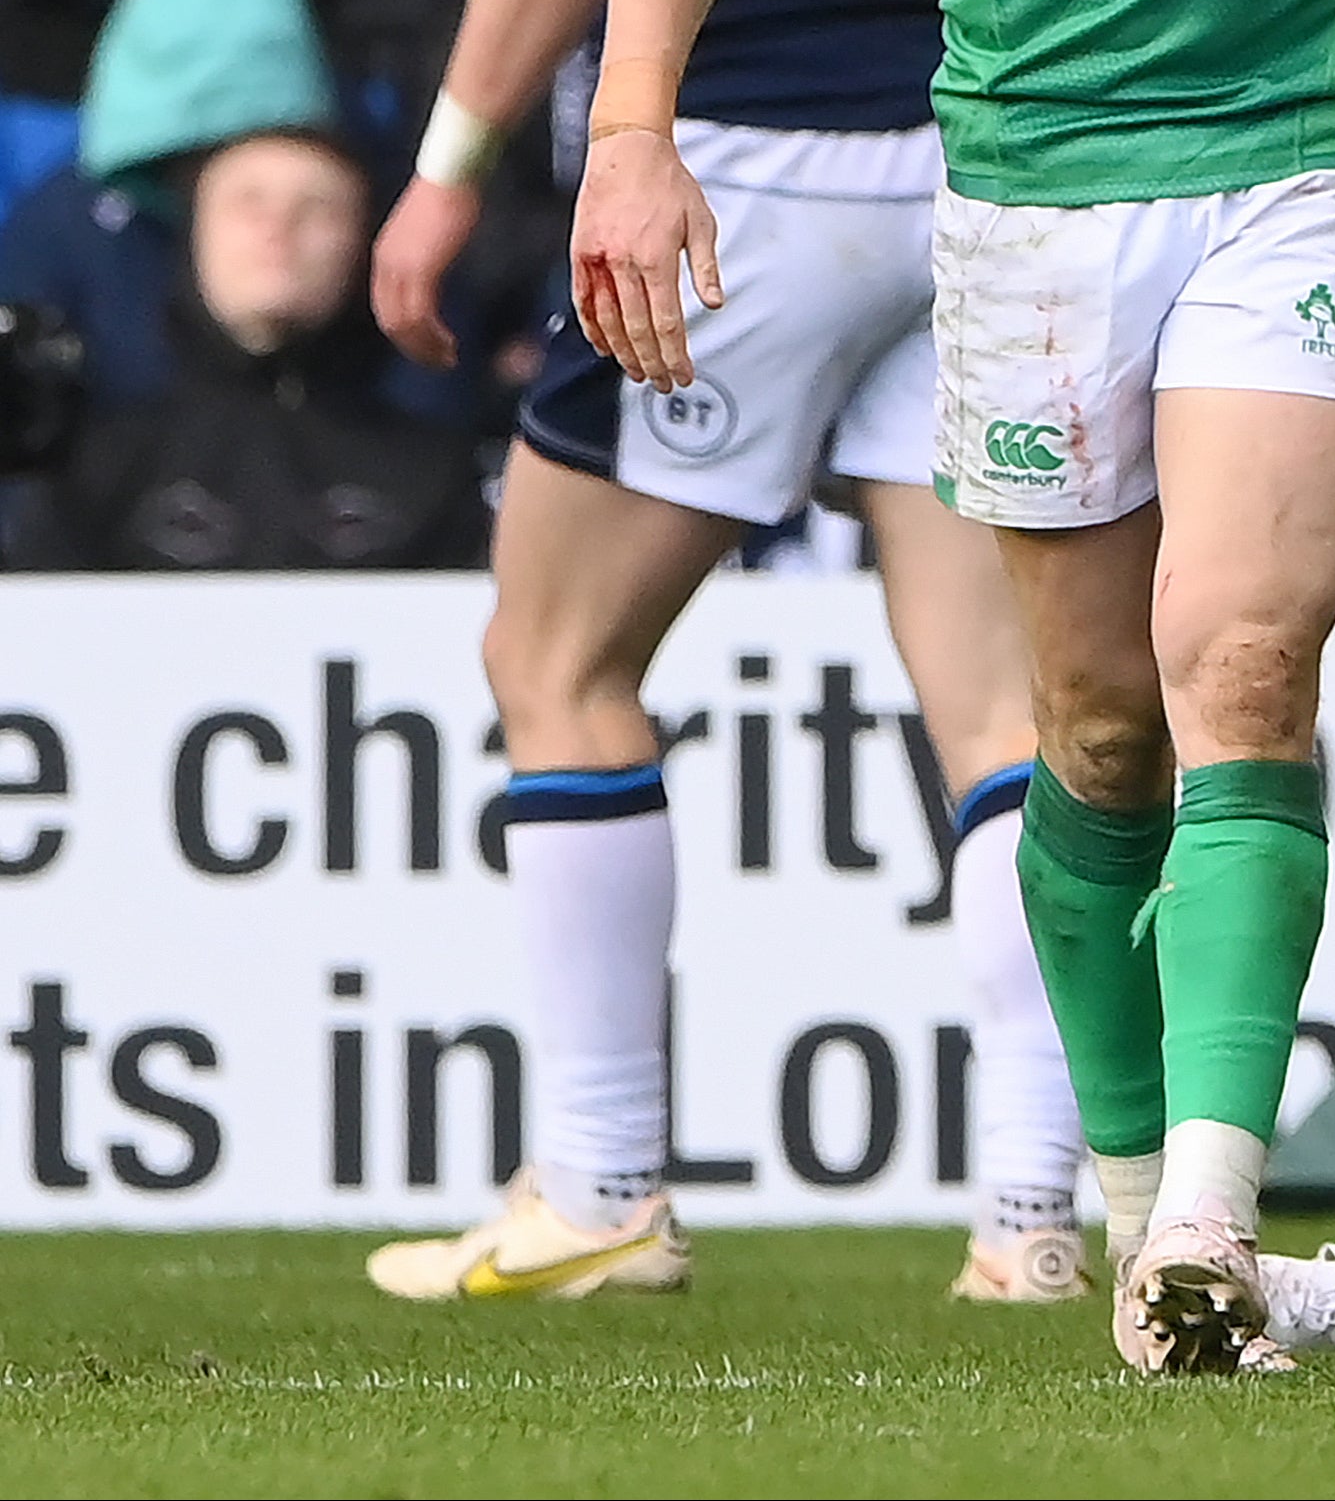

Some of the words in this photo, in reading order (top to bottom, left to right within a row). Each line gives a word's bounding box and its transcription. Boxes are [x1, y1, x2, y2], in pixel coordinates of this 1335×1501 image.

[667, 396, 712, 428] BT
[982, 468, 1067, 491] canterbury
[333, 971, 523, 1186] in
